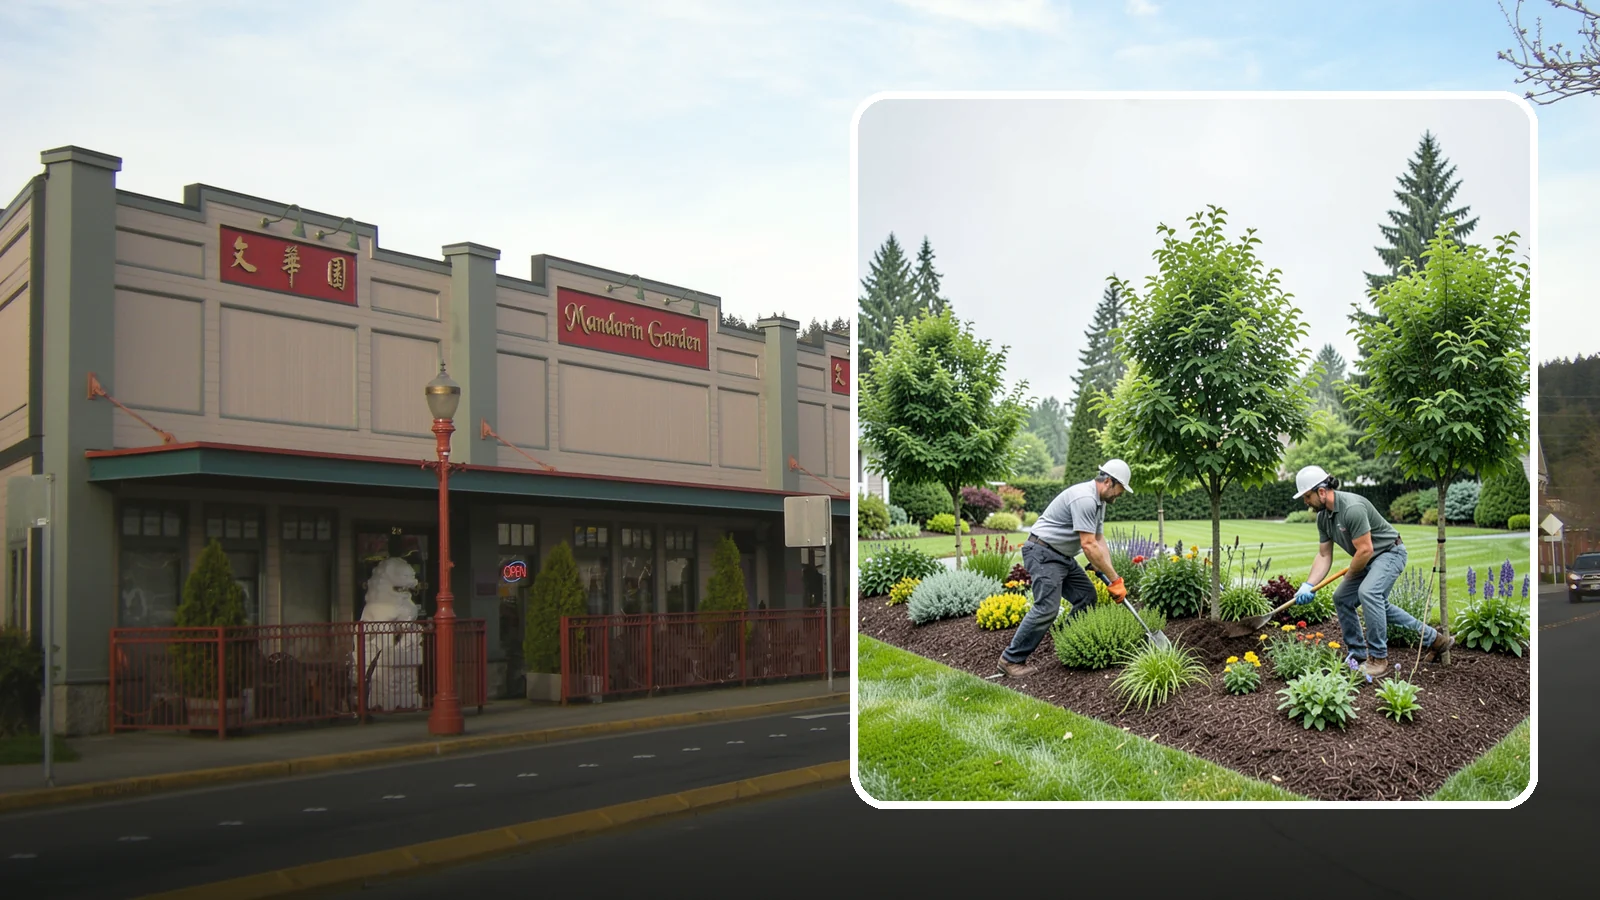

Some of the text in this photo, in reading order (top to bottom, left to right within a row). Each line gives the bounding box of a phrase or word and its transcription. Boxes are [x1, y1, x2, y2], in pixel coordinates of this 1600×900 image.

[230, 235, 346, 291] 文華園
[564, 302, 702, 352] Mandarin Garden
[503, 565, 527, 578] OPEN
